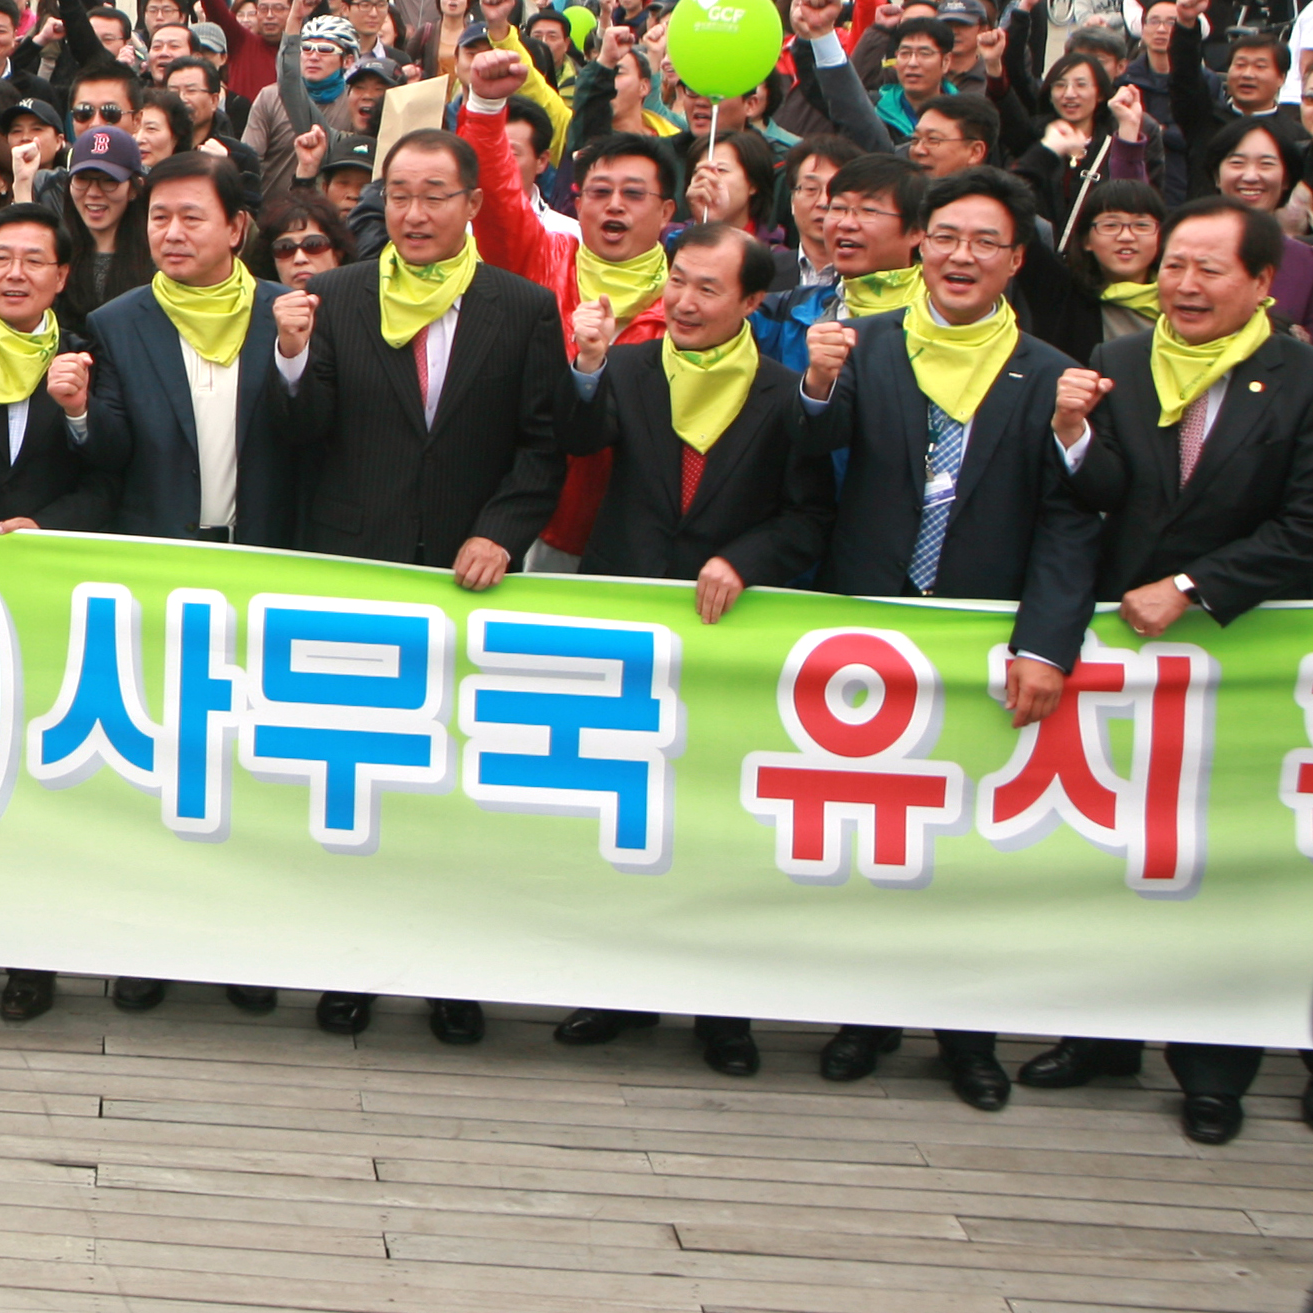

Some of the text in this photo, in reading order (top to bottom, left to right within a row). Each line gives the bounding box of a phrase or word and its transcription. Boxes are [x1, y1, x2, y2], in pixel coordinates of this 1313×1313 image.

[708, 6, 746, 23] GCF
[90, 132, 110, 155] B
[756, 632, 1191, 880] 유치
